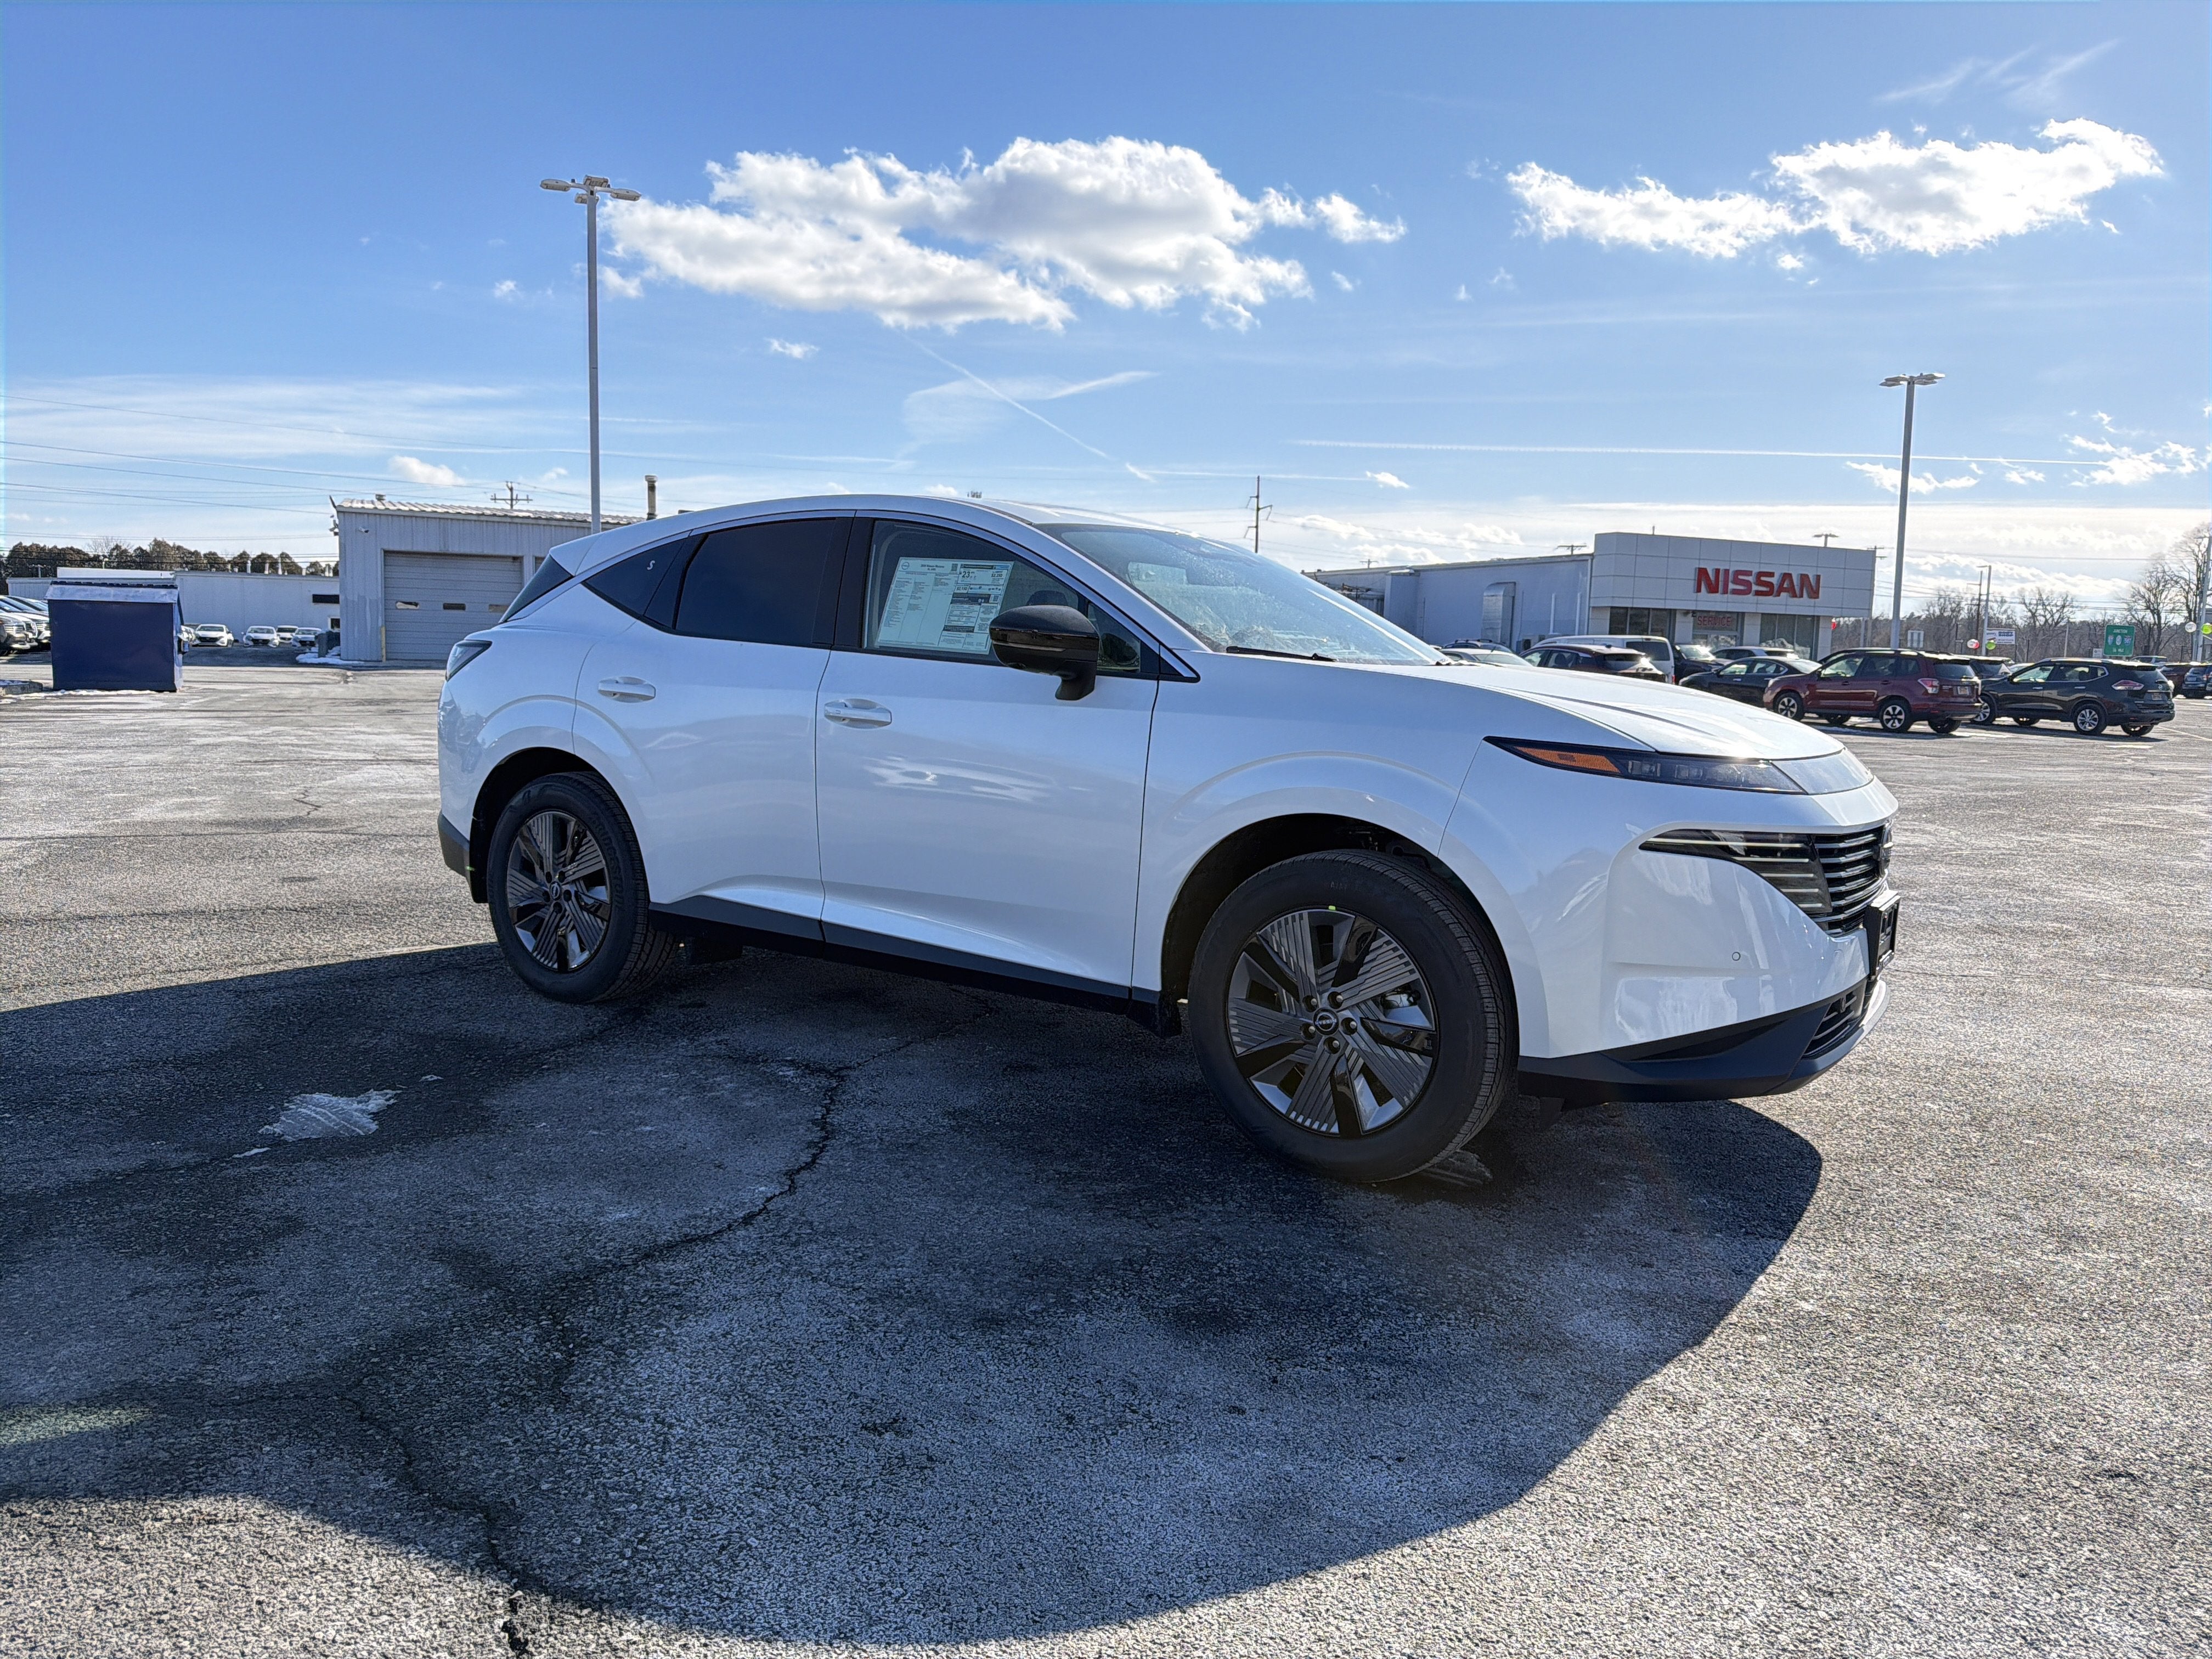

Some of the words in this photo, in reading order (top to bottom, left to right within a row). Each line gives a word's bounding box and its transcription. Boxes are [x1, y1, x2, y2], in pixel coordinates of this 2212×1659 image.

[647, 560, 656, 570] S
[1694, 567, 1821, 599] NISSAN
[1697, 616, 1731, 627] SERVICE
